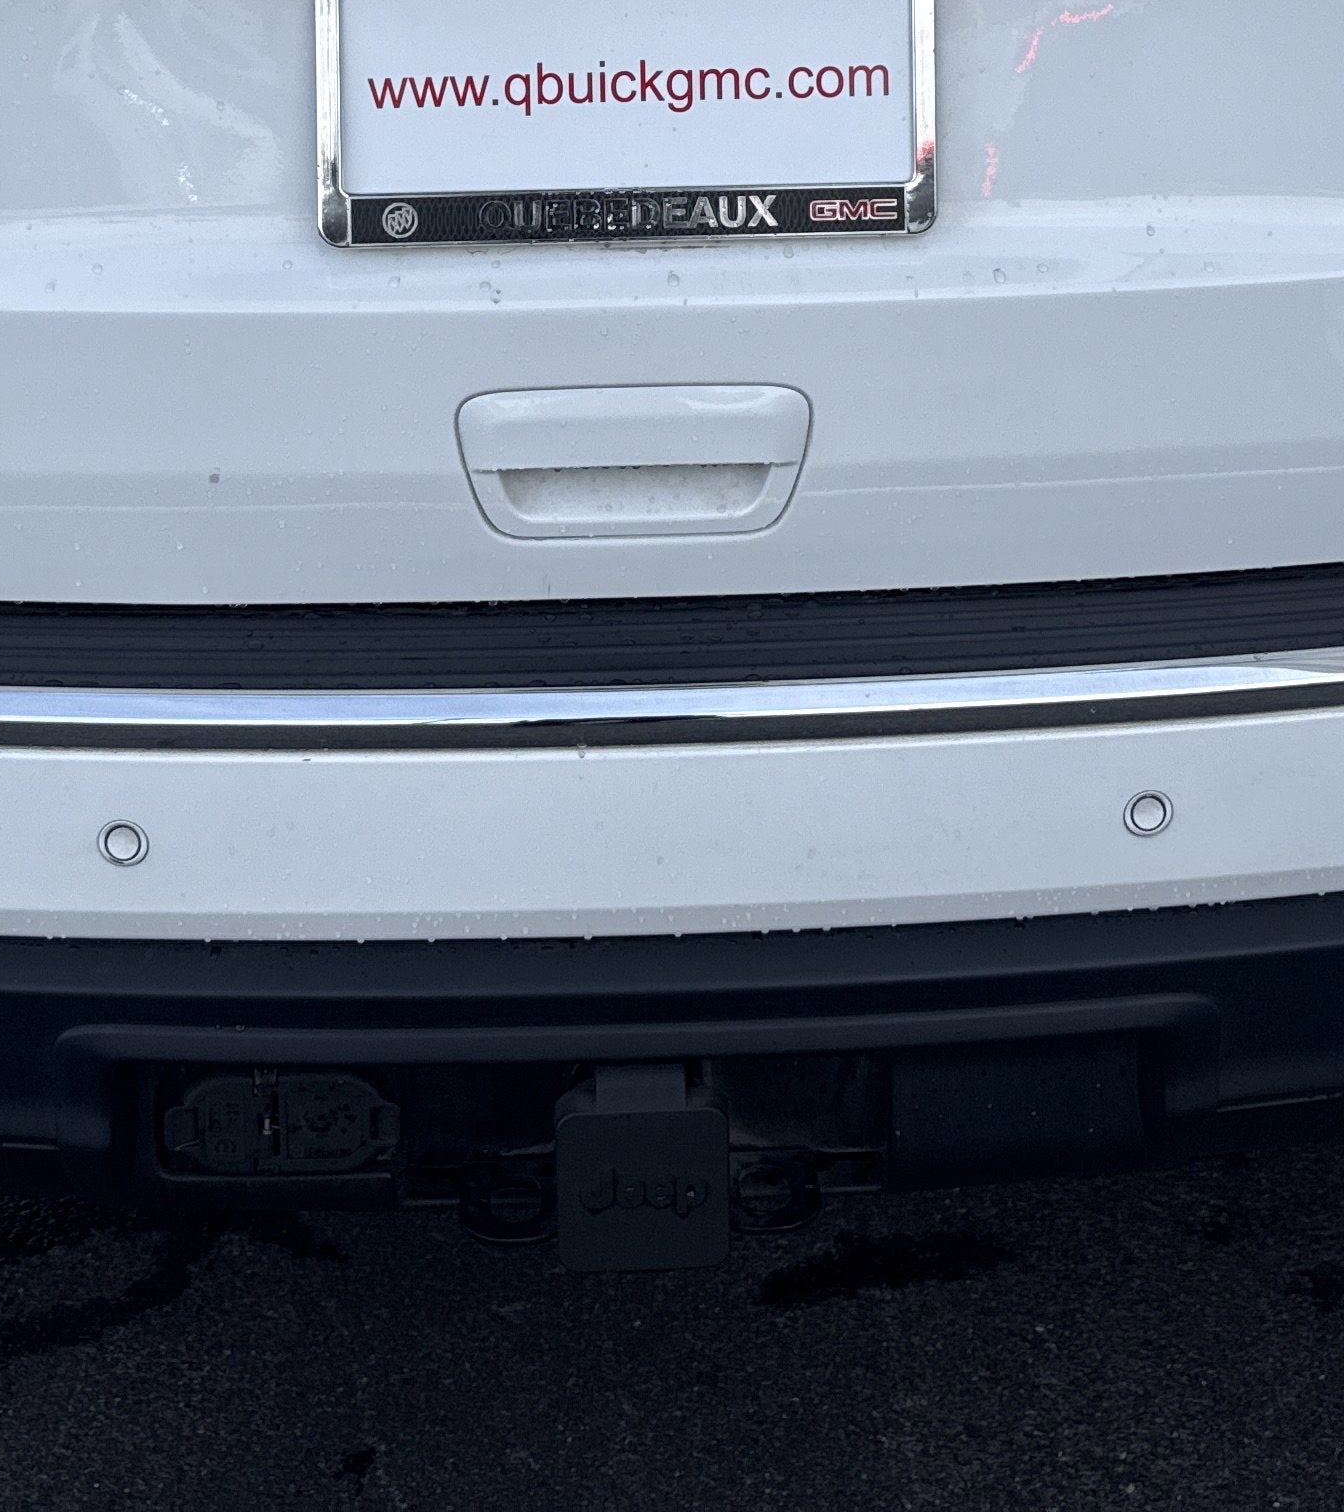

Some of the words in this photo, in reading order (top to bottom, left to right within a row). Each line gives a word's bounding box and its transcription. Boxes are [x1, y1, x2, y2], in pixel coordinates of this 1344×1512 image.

[367, 59, 891, 116] www.qbuickgmc.com
[478, 194, 779, 232] QUEBEDEAUX
[809, 198, 899, 222] GMC
[578, 1168, 708, 1220] Jeep
